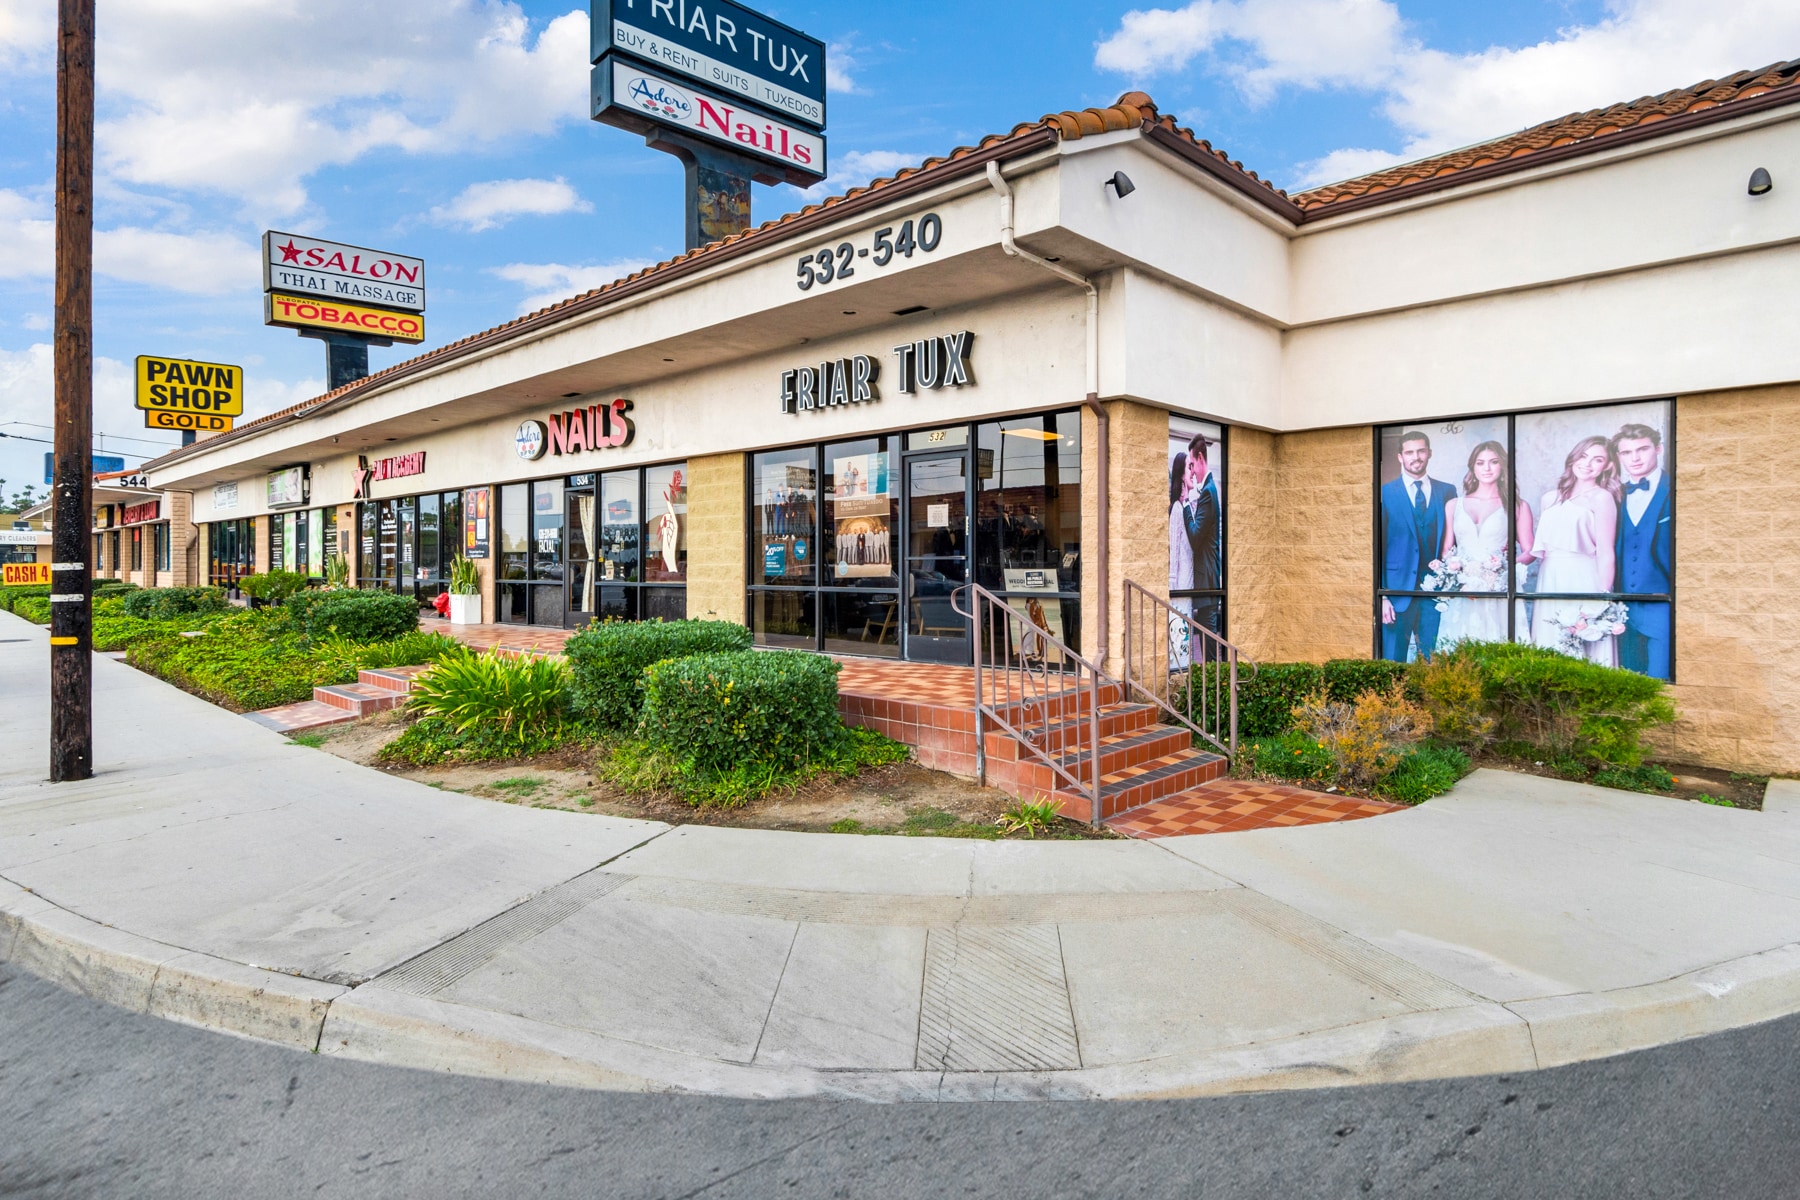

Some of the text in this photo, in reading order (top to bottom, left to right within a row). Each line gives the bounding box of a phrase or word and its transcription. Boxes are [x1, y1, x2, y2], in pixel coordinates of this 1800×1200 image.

[616, 28, 698, 71] BUY & RENT
[627, 0, 810, 84] RIAR TUX
[712, 67, 749, 91] SUITS
[630, 79, 690, 111] Adore
[764, 87, 819, 118] TUXEDOS
[695, 97, 812, 165] Nails
[303, 248, 419, 283] SALON
[797, 212, 943, 291] 532-540
[276, 296, 321, 307] CLEOPATRA
[279, 272, 417, 305] THAI MASSAGE
[276, 301, 419, 334] TOBACCO
[386, 330, 419, 338] EXPRESS
[147, 360, 233, 389] PAWN
[780, 331, 976, 414] FRIAR TUX
[149, 384, 231, 411] SHOP
[157, 412, 225, 430] GOLD
[516, 425, 541, 444] Adore
[547, 398, 635, 456] NAILS
[929, 431, 945, 442] 532
[392, 452, 426, 478] ACADEMY
[119, 475, 148, 488] 544
[576, 475, 589, 486] 534
[6, 565, 49, 583] CASH 4
